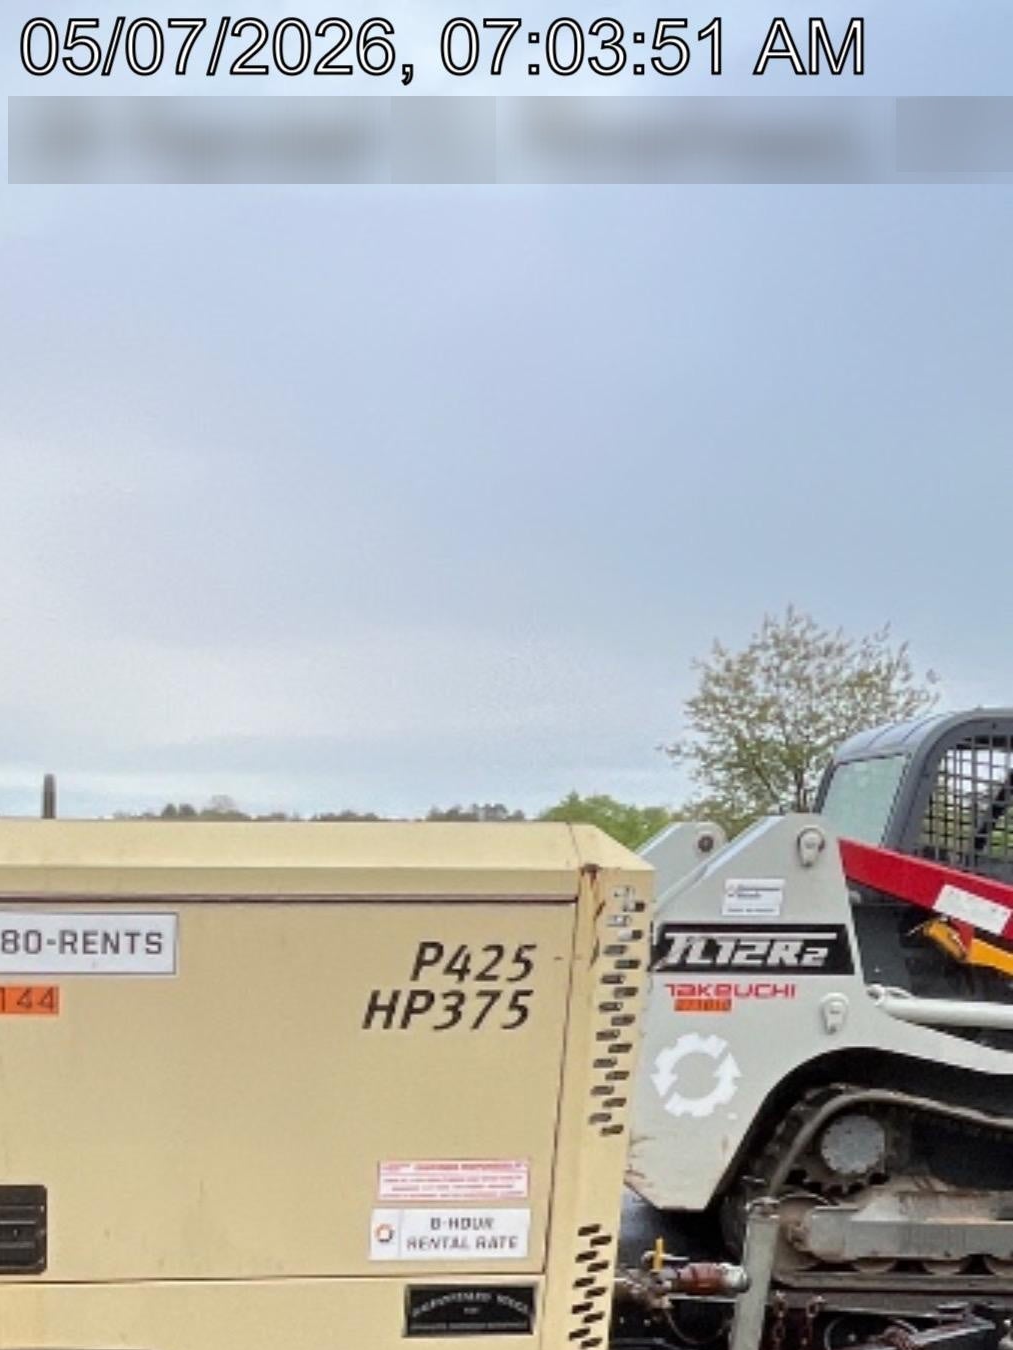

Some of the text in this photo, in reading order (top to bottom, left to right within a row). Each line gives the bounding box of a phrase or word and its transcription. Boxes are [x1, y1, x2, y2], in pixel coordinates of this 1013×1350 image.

[1, 928, 163, 955] 80-RENTS
[410, 941, 537, 983] P425
[362, 989, 534, 1030] HP375
